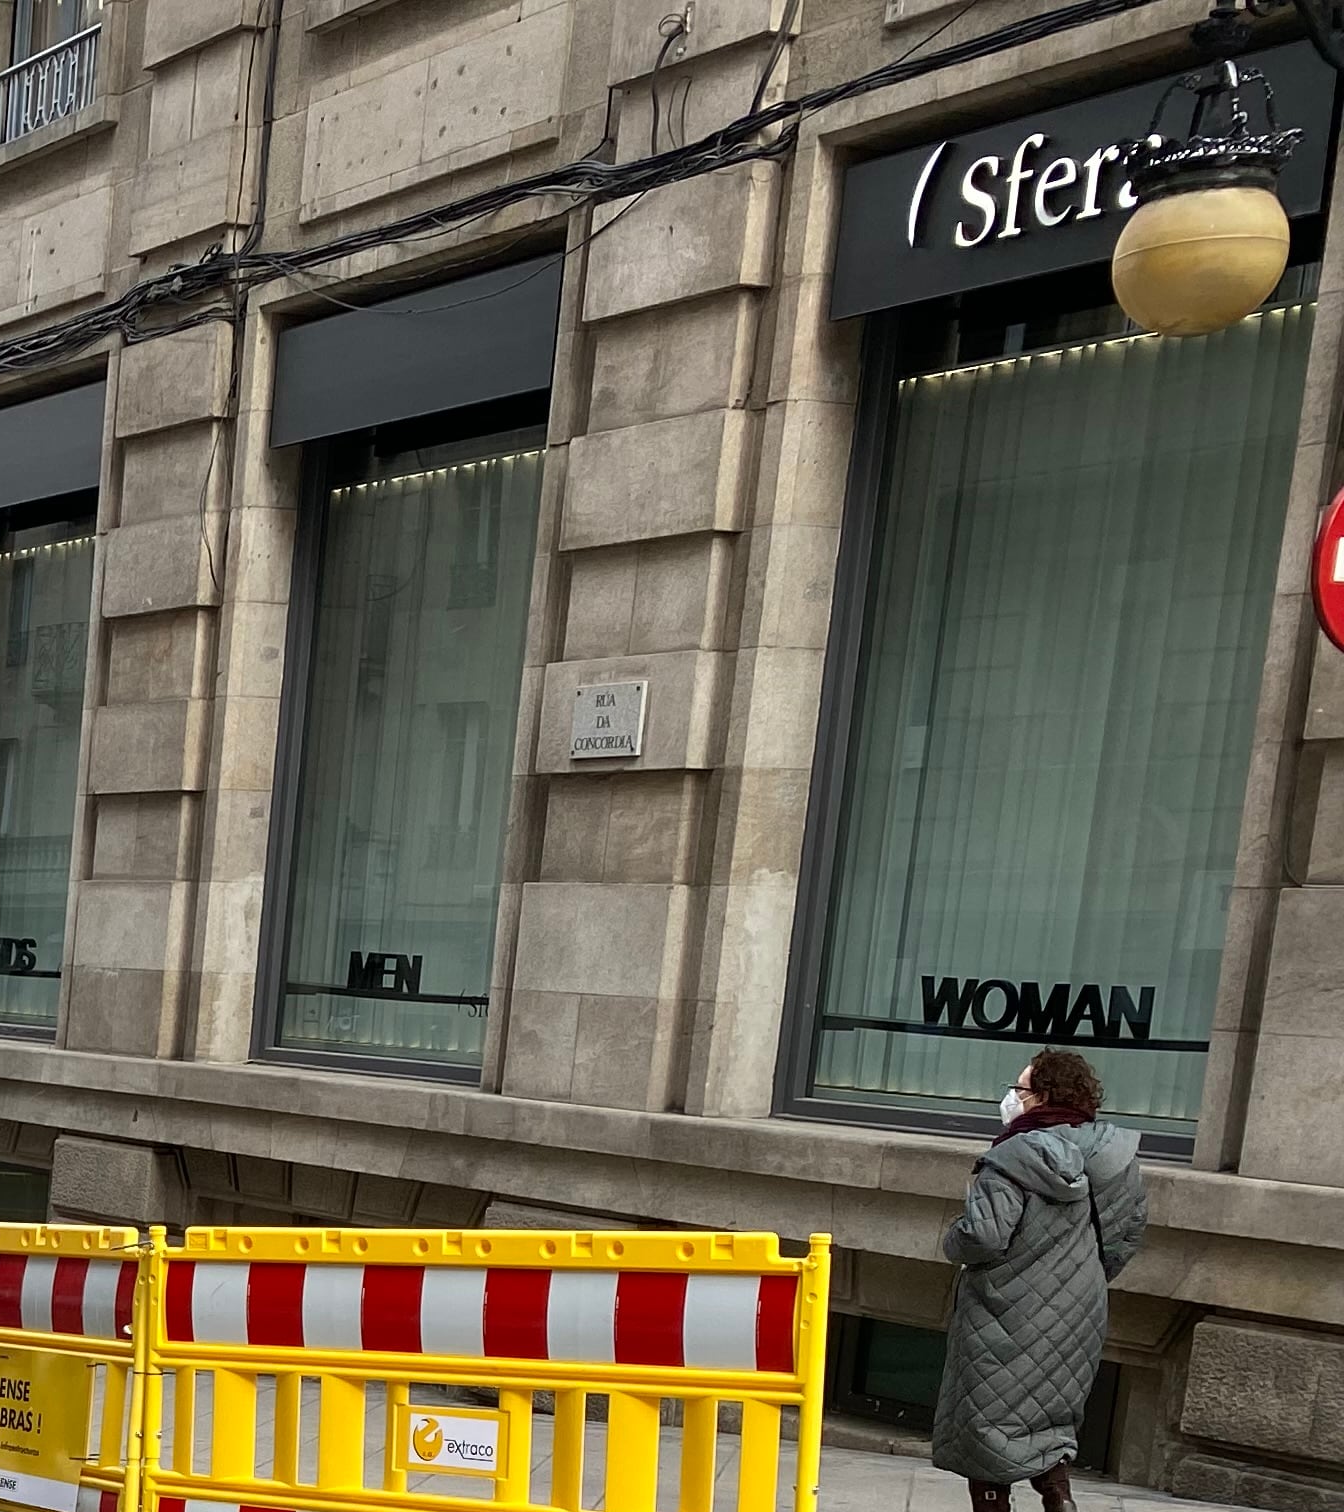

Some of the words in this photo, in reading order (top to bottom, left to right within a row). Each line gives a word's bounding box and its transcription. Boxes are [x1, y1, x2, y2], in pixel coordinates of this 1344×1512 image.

[596, 715, 611, 728] DA
[574, 735, 634, 751] CONCORDIA
[347, 951, 423, 995] MEN
[921, 975, 1156, 1040] WOMAN
[447, 1440, 494, 1457] extraco
